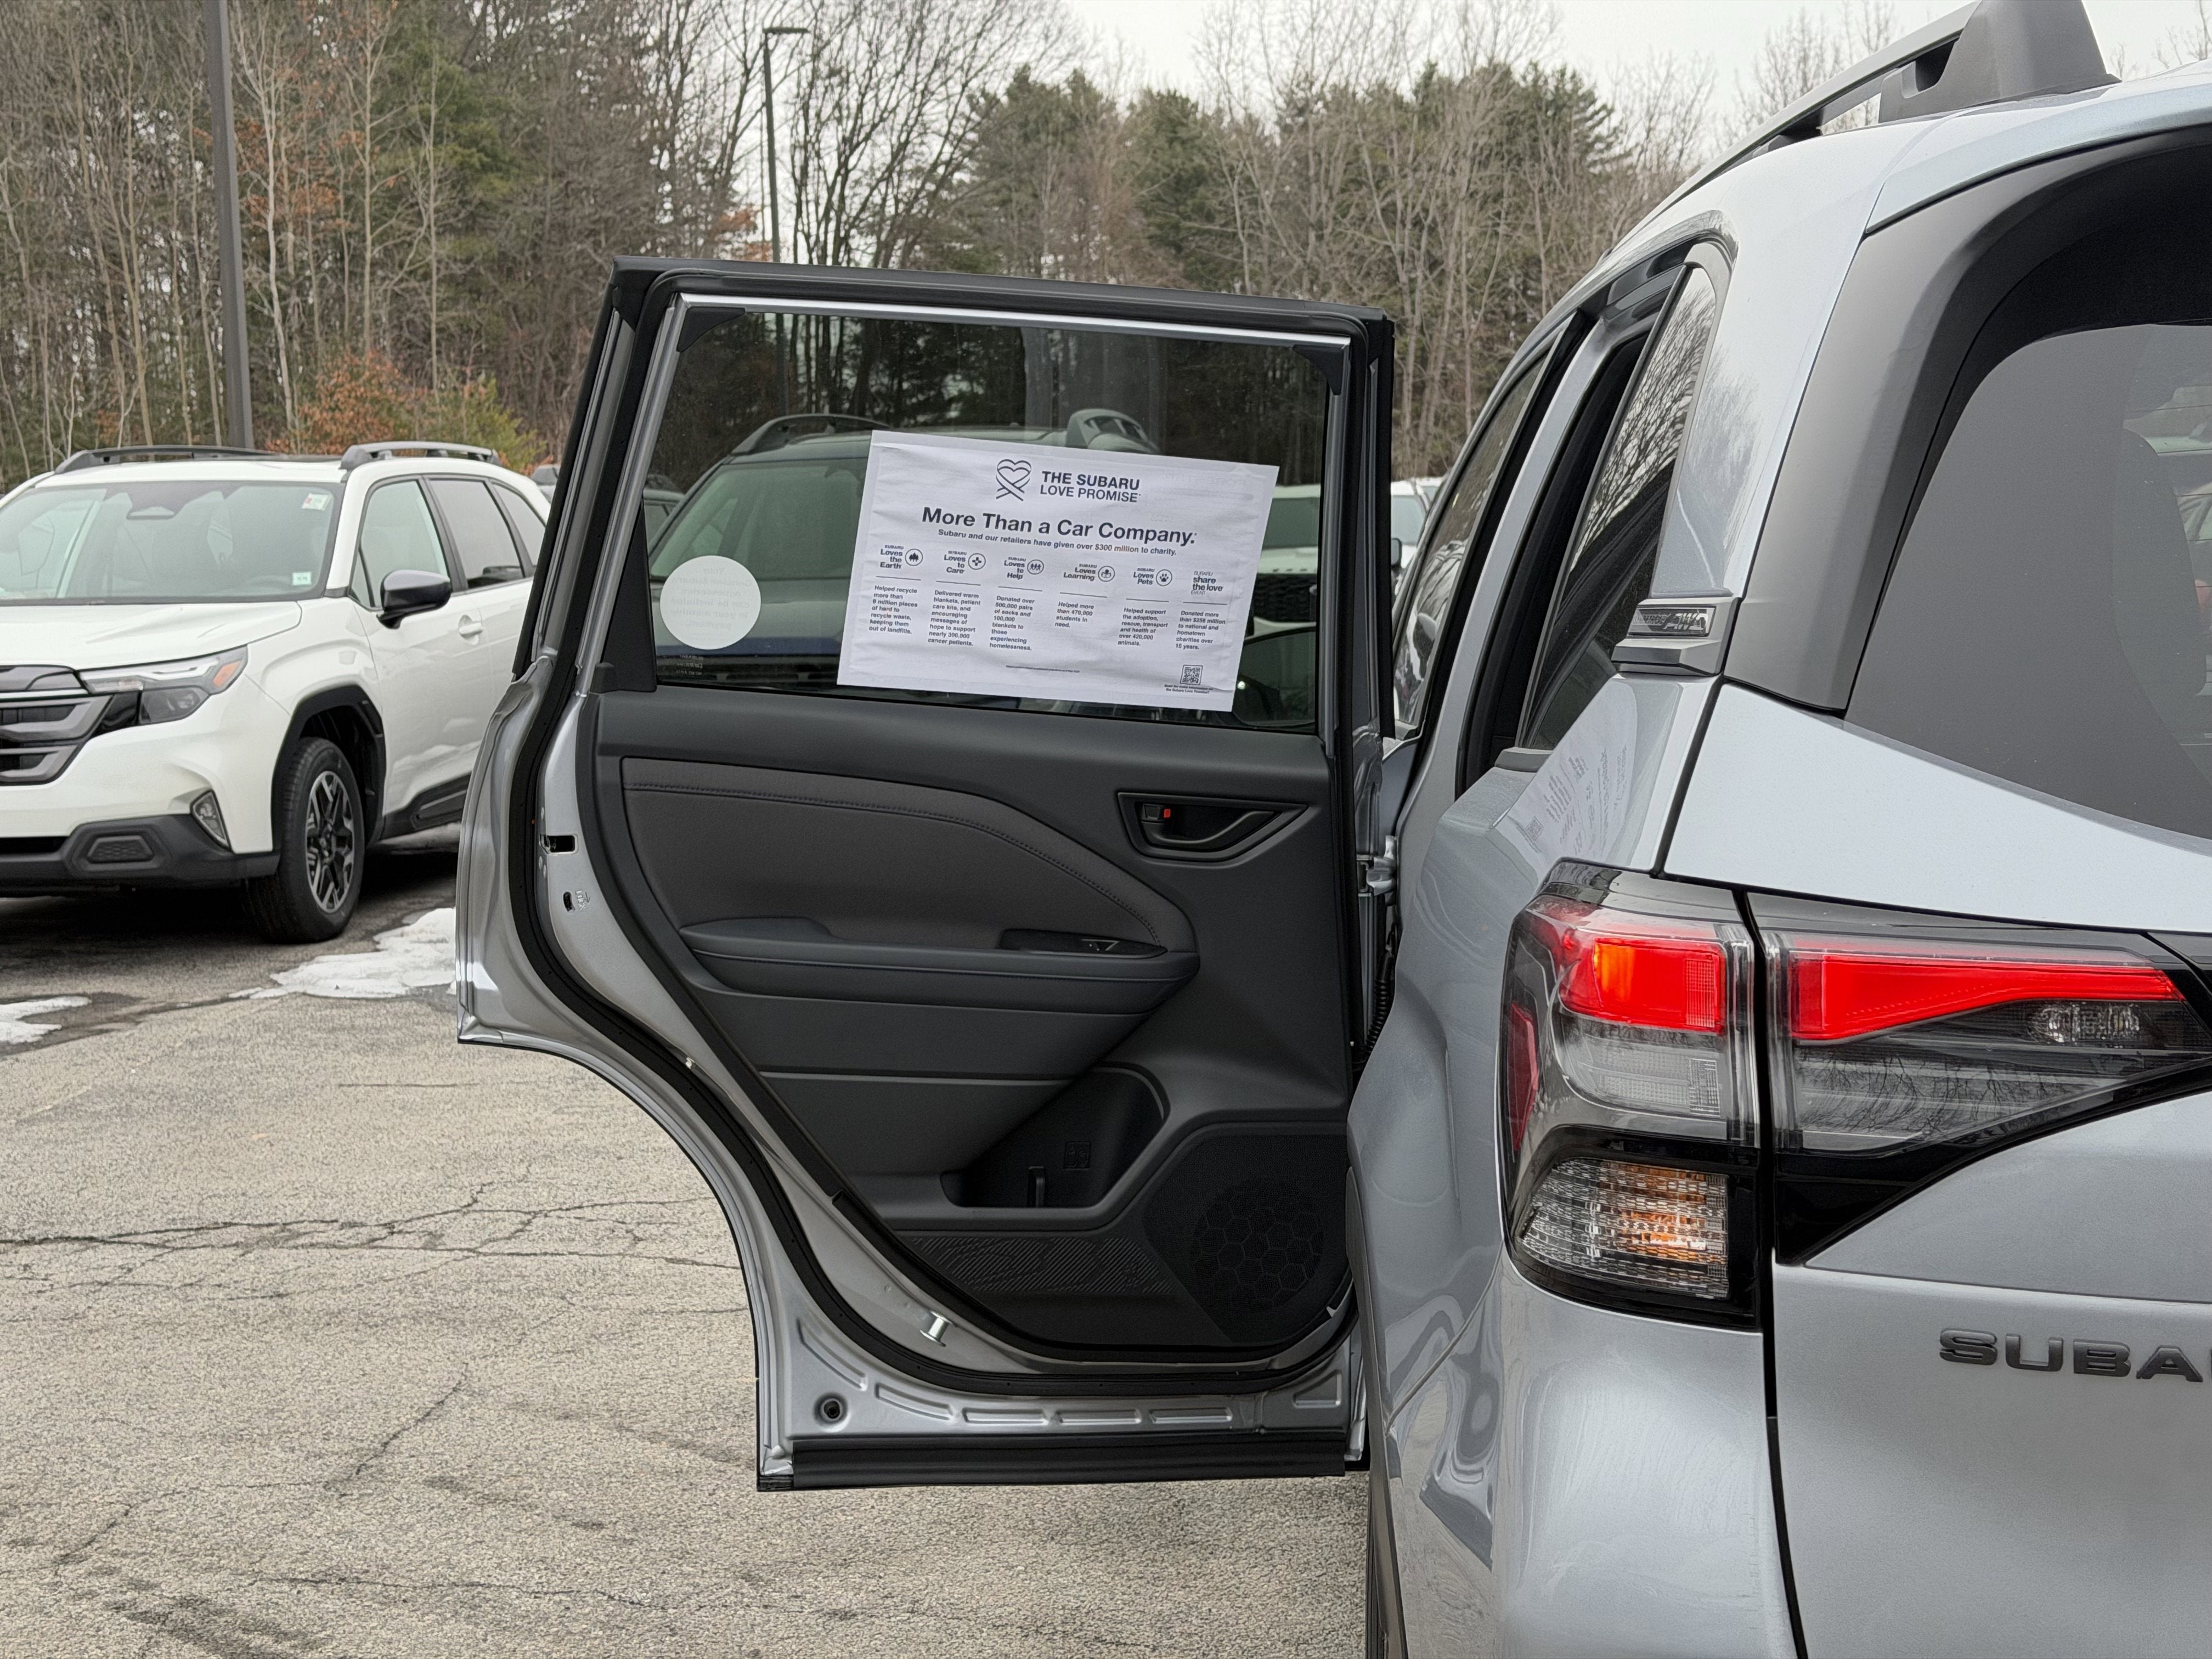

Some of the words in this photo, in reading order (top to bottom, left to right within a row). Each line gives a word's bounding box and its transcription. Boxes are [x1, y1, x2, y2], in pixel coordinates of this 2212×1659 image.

[1042, 471, 1072, 484] THE
[1076, 473, 1140, 490] SUBARU
[1040, 484, 1075, 497] LOVE
[1077, 487, 1141, 503] PROMISE
[922, 506, 975, 527] More
[983, 512, 1032, 533] Than
[1038, 522, 1051, 534] a
[1057, 519, 1093, 537] Car
[938, 529, 967, 538] Subaru
[1000, 537, 1031, 545] retailers
[1034, 539, 1052, 547] have
[1095, 543, 1113, 551] $300
[1114, 545, 1139, 553] million
[1150, 547, 1176, 556] charity.
[881, 548, 903, 557] Loves
[944, 554, 966, 562] Loves
[880, 561, 902, 569] Earth
[1004, 560, 1025, 568] Loves
[1063, 572, 1095, 582] Learning
[932, 611, 968, 619] encouraging
[990, 636, 1027, 645] experiencing
[989, 642, 1032, 651] homelessness.
[1939, 1327, 2212, 1383] SUBA
